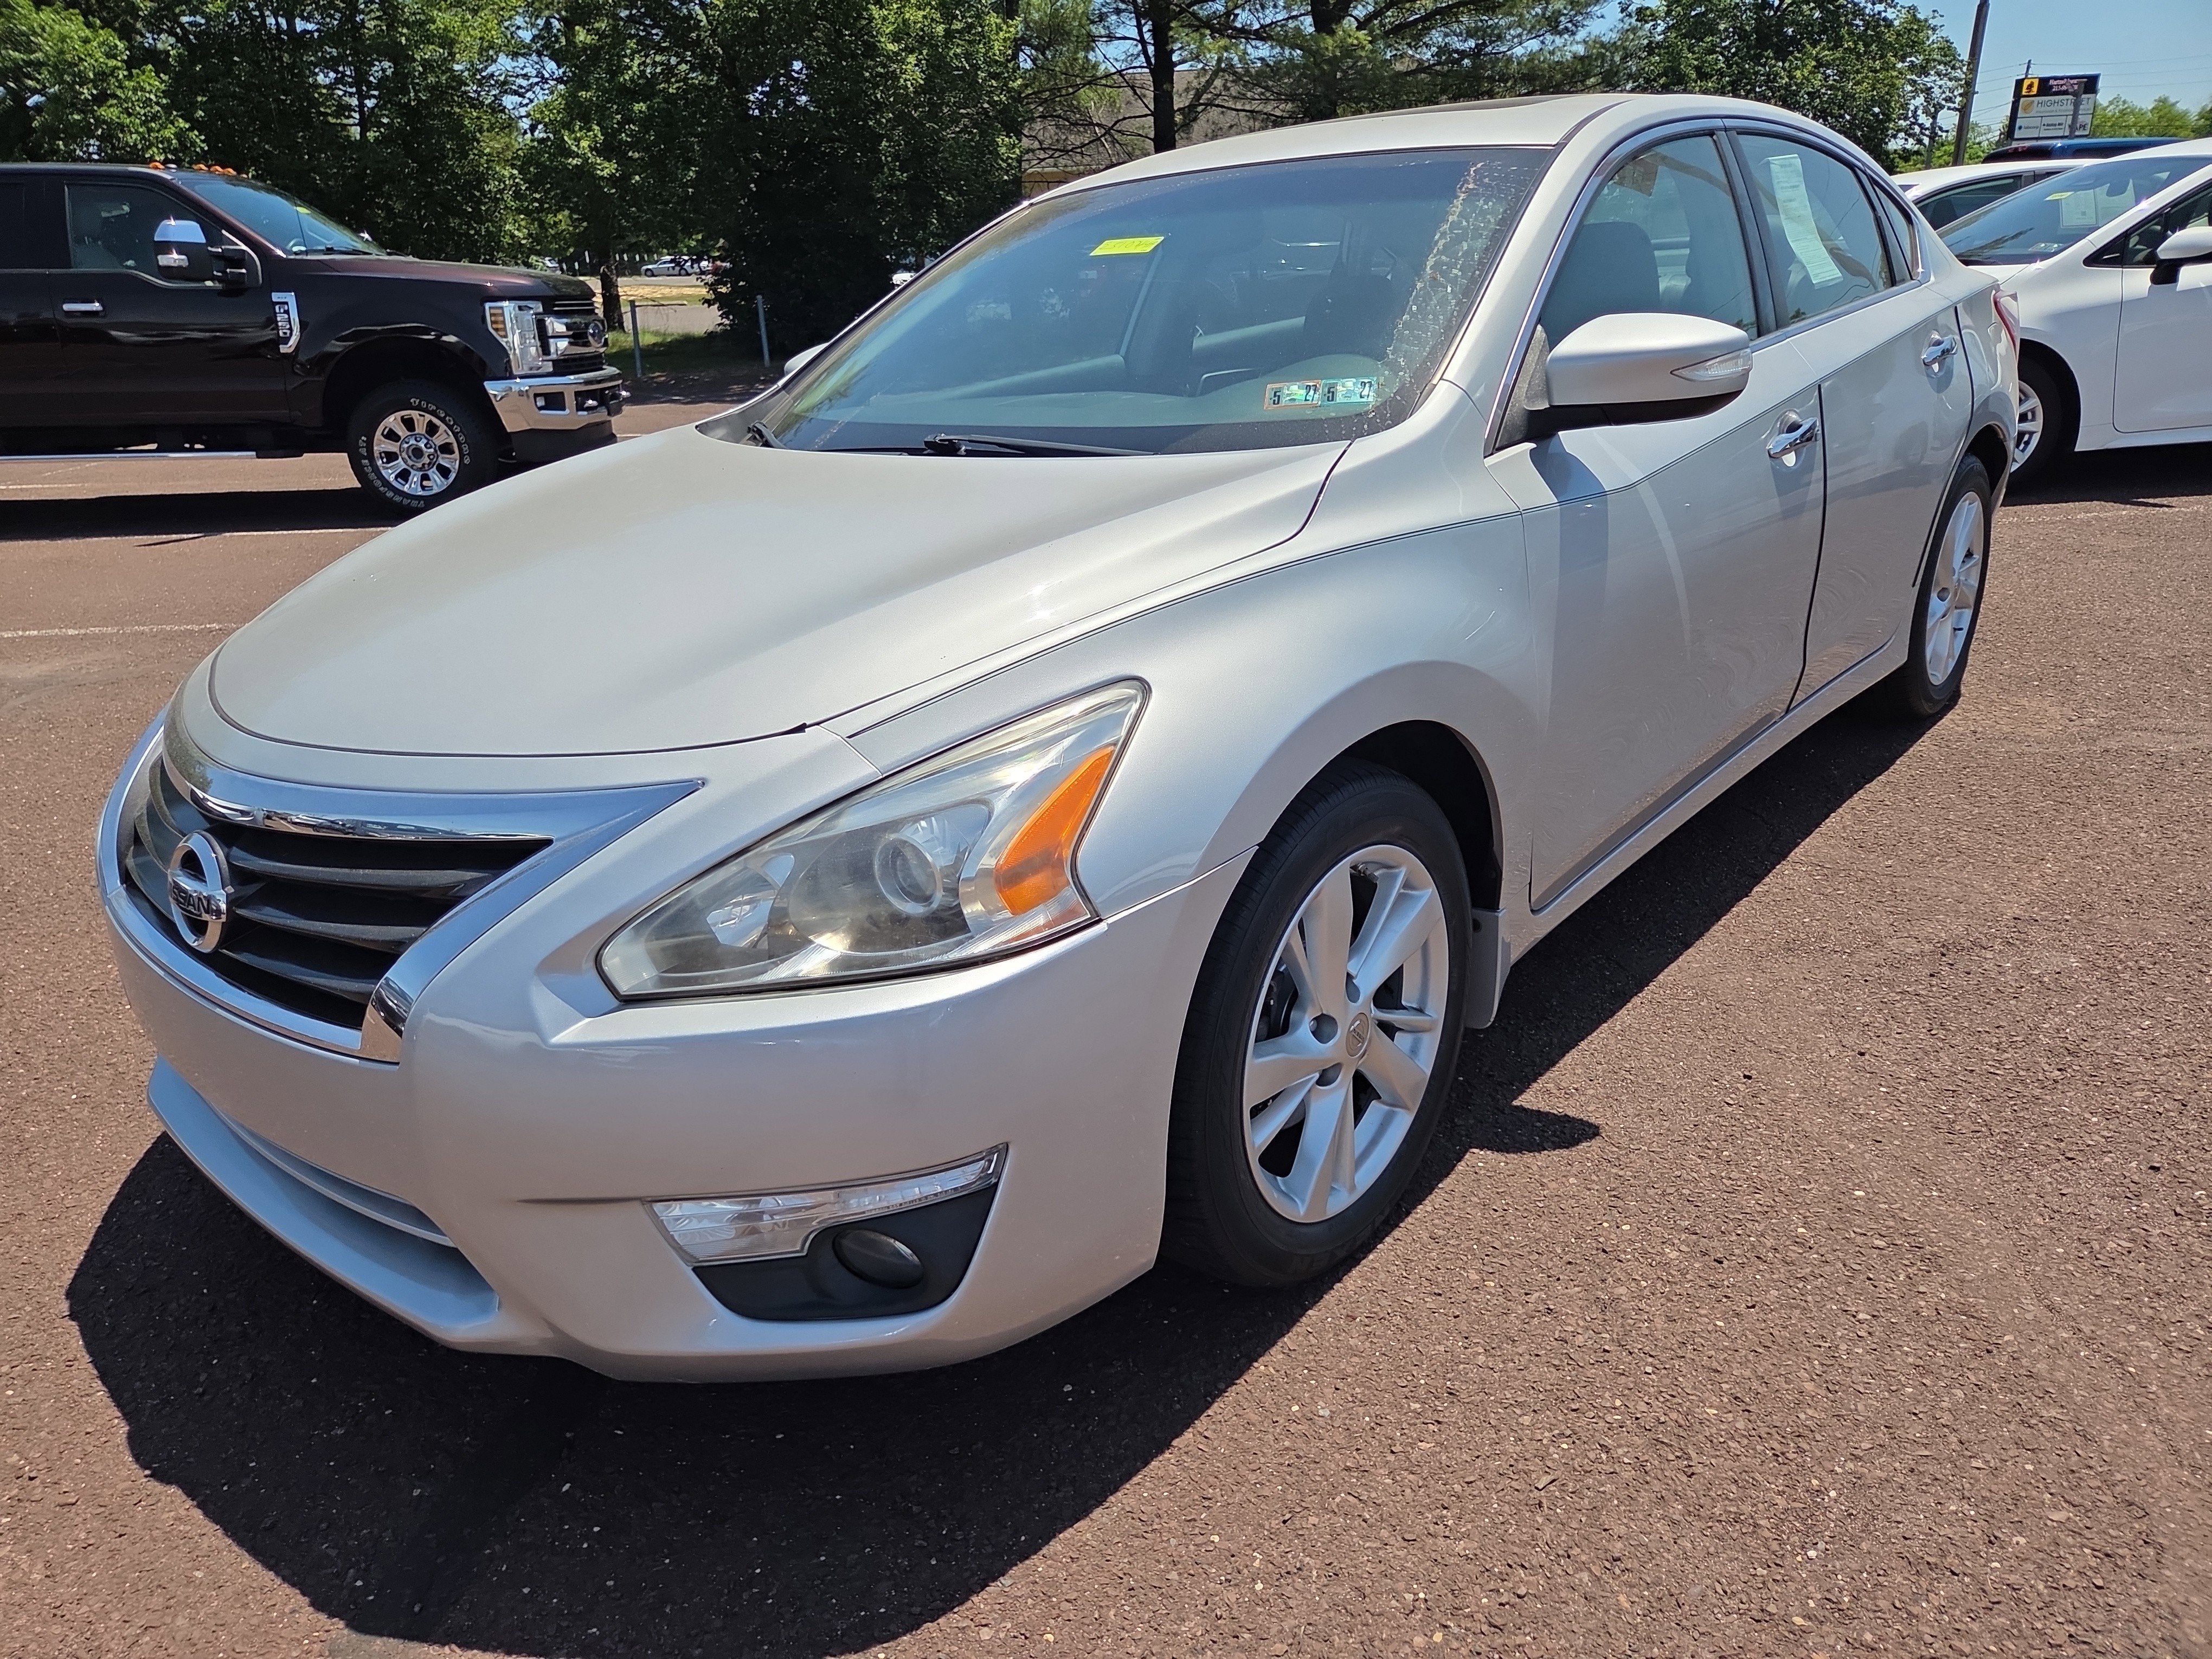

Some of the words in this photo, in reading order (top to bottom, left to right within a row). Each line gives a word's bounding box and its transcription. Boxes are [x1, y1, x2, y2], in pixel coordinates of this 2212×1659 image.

[2036, 98, 2092, 108] HIGHSTRET
[2068, 123, 2088, 132] PE
[1272, 390, 1281, 406] 5
[1304, 384, 1317, 403] 27
[1327, 387, 1335, 402] 5
[1359, 381, 1372, 400] 27
[169, 882, 211, 915] ISSAN
